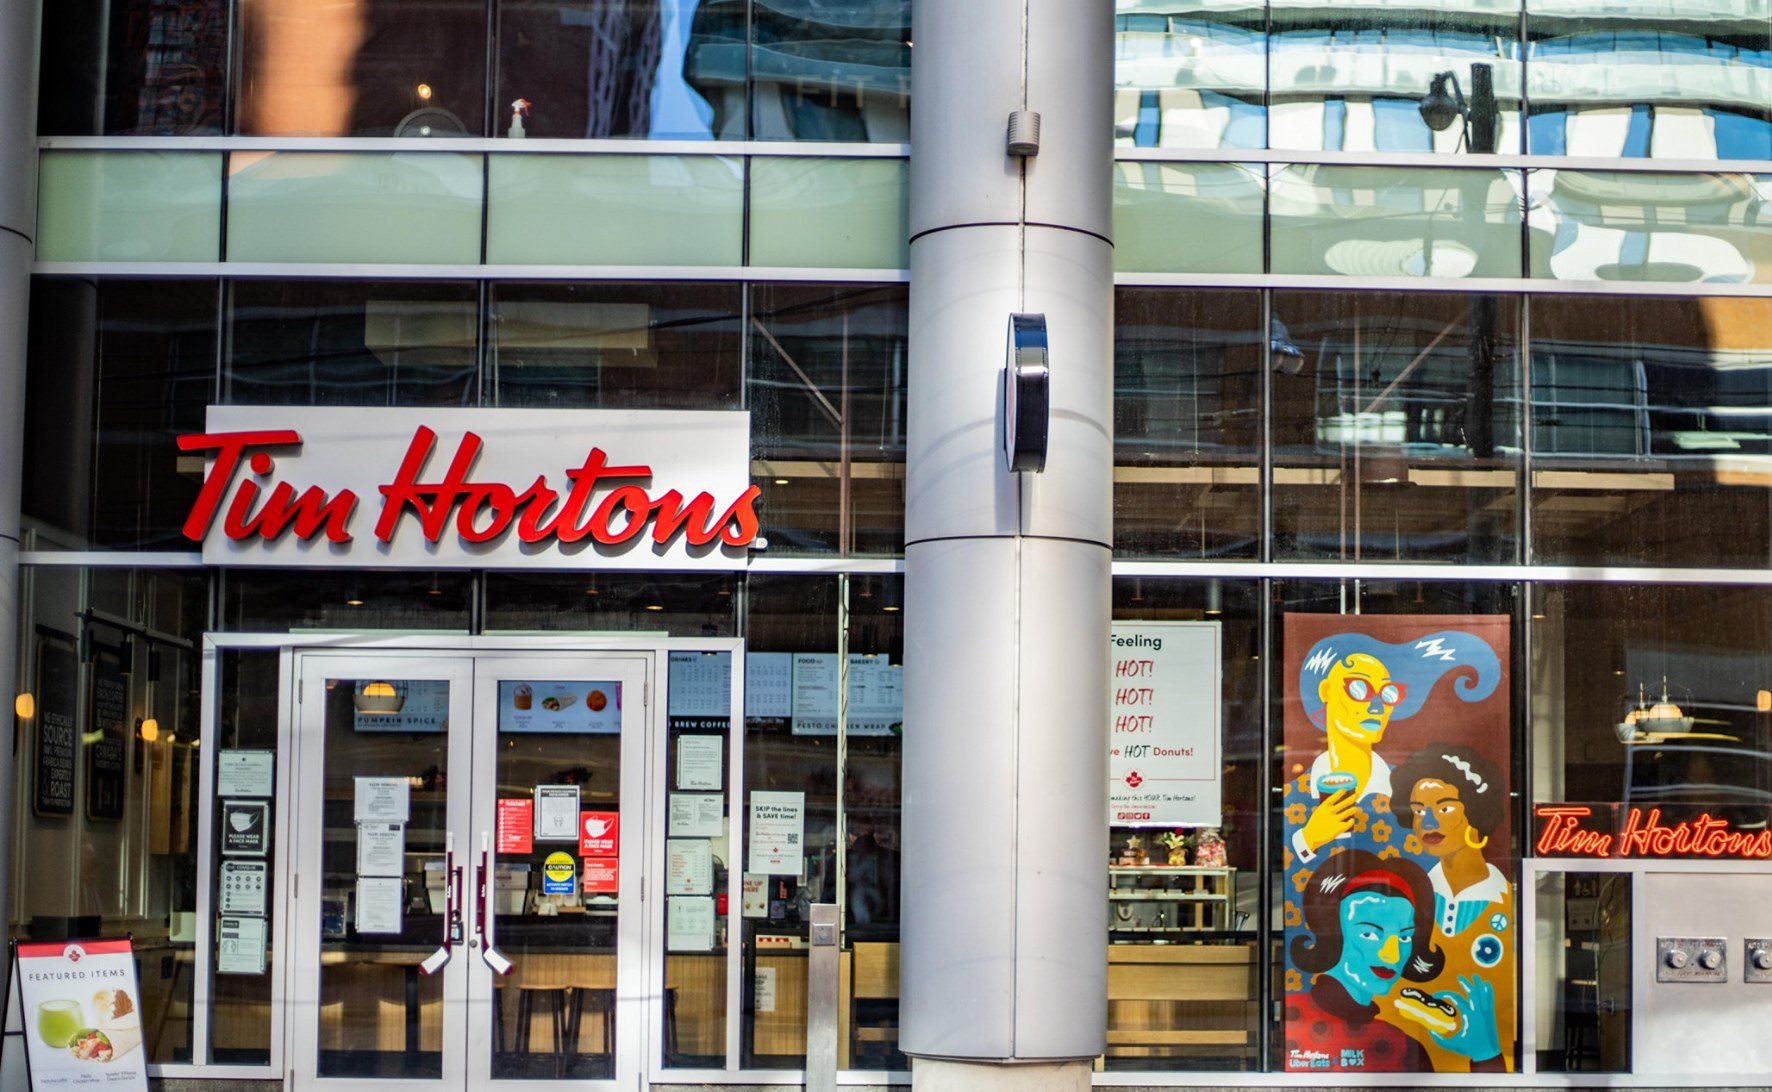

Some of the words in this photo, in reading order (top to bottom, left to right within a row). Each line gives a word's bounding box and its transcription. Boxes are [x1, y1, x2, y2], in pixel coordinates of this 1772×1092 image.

[176, 429, 359, 543] Tim
[378, 424, 760, 546] Hortons
[1116, 660, 1154, 677] HOT!
[1115, 688, 1154, 705] HOT!
[1115, 716, 1154, 733] HOT!
[43, 726, 73, 746] SOURCE
[1124, 745, 1151, 758] HOT
[1153, 747, 1193, 756] Donuts!
[51, 782, 71, 798] ROAST
[1537, 807, 1612, 856] Tim
[1621, 808, 1772, 856] Hortons
[29, 971, 86, 981] FEATURED
[91, 969, 125, 978] ITEMS
[1290, 1049, 1303, 1058] Tim
[1303, 1050, 1329, 1059] Hortons
[1341, 1049, 1364, 1058] MILK
[1290, 1059, 1309, 1068] Uber
[1309, 1058, 1330, 1068] Eats
